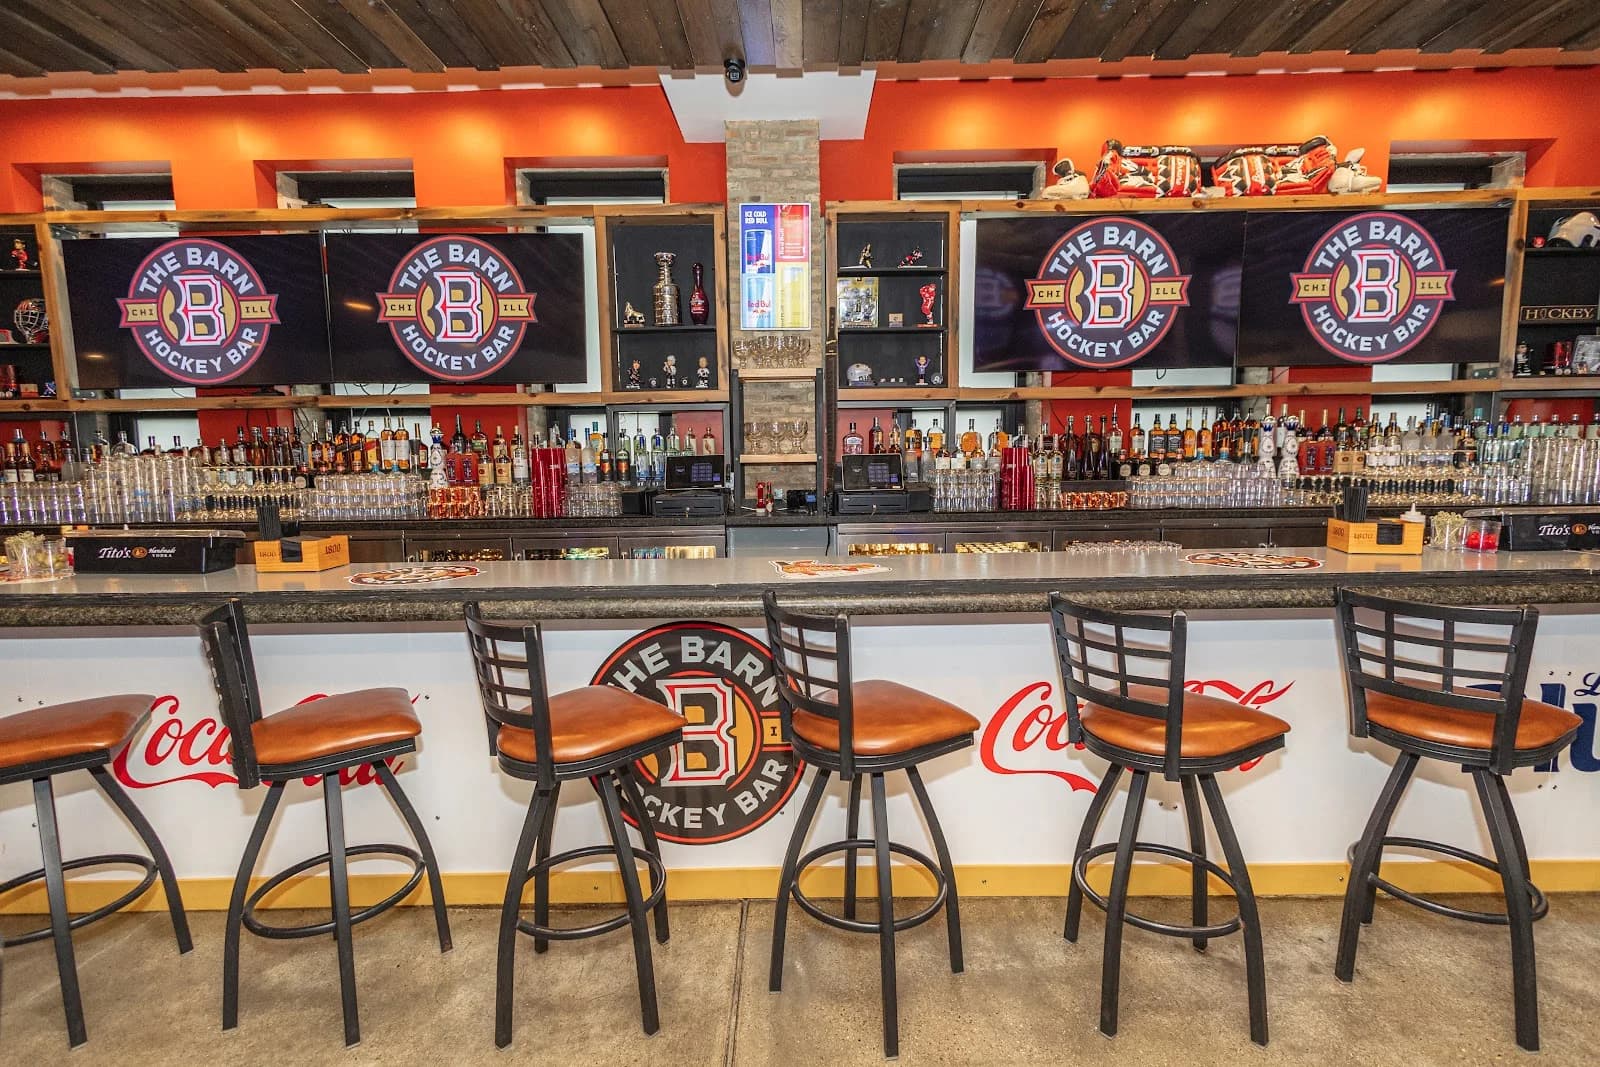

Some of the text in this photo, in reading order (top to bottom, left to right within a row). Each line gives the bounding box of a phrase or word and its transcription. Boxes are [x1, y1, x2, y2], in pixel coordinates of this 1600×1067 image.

[399, 244, 514, 292] THE BARN
[1049, 226, 1169, 276] THE BARN
[1314, 221, 1434, 270] THE BARN
[139, 247, 254, 295] THE BARN
[1038, 287, 1176, 298] CHI ILL
[1082, 254, 1135, 328] B
[1303, 284, 1326, 292] CHI
[1348, 249, 1400, 322] B
[132, 308, 154, 316] CHI
[173, 275, 227, 345] B
[433, 272, 483, 342] B
[1313, 304, 1431, 351] HOCKEY BAR
[145, 328, 258, 374] HOCKEY BAR
[402, 324, 515, 371] HOCKEY BAR
[1048, 310, 1165, 358] HOCKEY BAR
[98, 546, 131, 559] Tito's
[1538, 524, 1571, 536] Tito's
[608, 636, 780, 708] HE BARN
[734, 758, 788, 816] BAR
